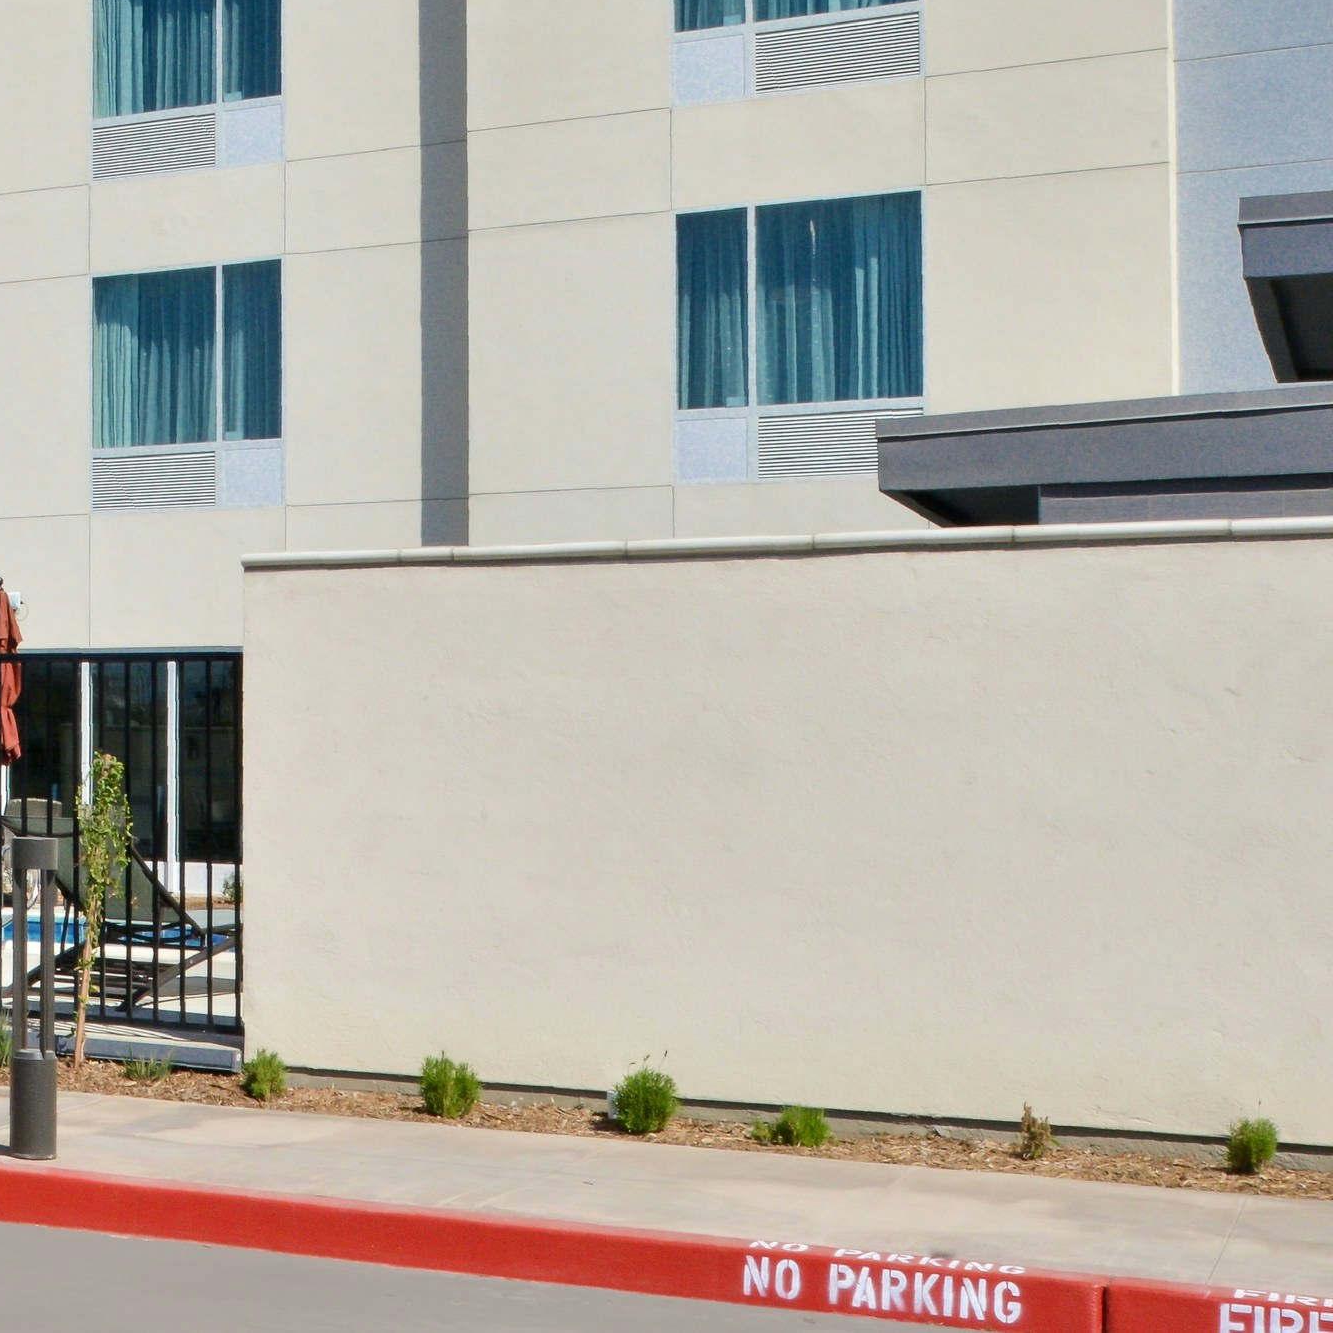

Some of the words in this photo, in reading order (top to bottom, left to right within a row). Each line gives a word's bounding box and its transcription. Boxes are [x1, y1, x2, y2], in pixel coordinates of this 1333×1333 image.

[749, 1240, 809, 1252] NO
[835, 1248, 1026, 1275] PARKING
[743, 1255, 801, 1301] NO
[829, 1263, 1022, 1324] PARKING
